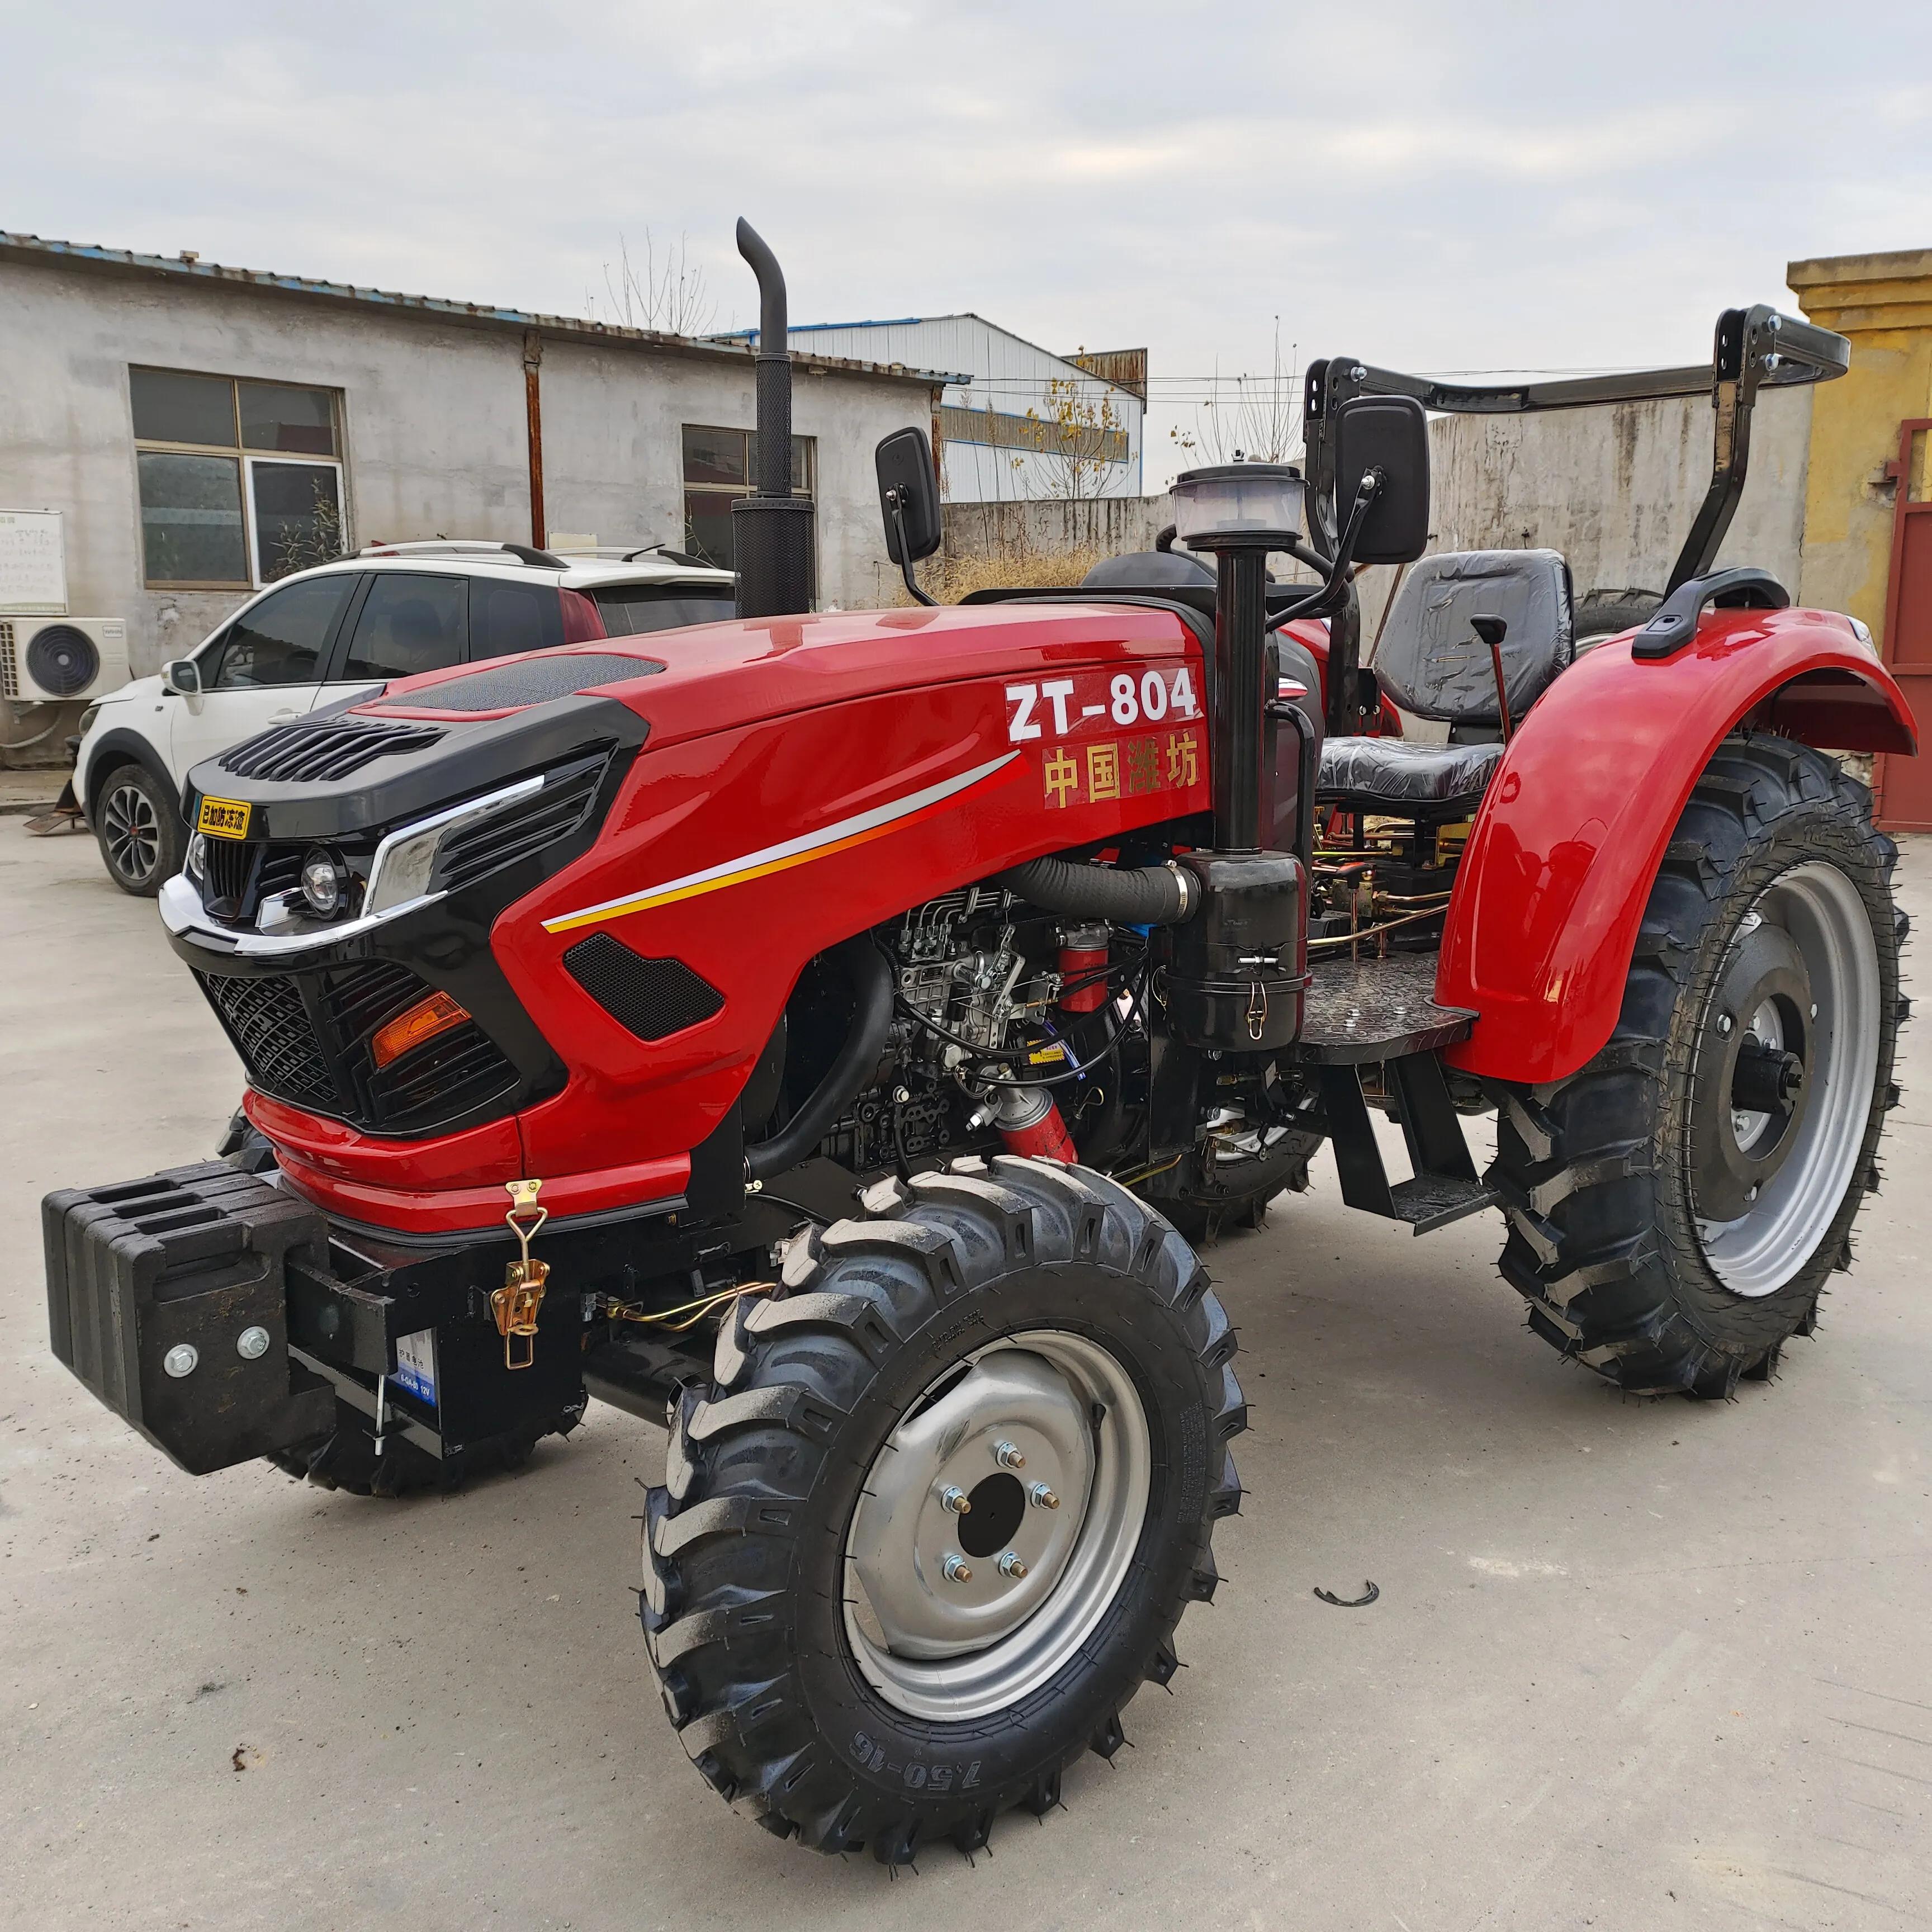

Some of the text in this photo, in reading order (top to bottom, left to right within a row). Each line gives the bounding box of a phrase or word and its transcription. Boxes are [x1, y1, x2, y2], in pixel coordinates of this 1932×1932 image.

[1006, 667, 1196, 742] ZT-804
[1044, 731, 1197, 808] 中国潍坊
[420, 1385, 430, 1396] 12V
[849, 1731, 981, 1791] 7.50-16
